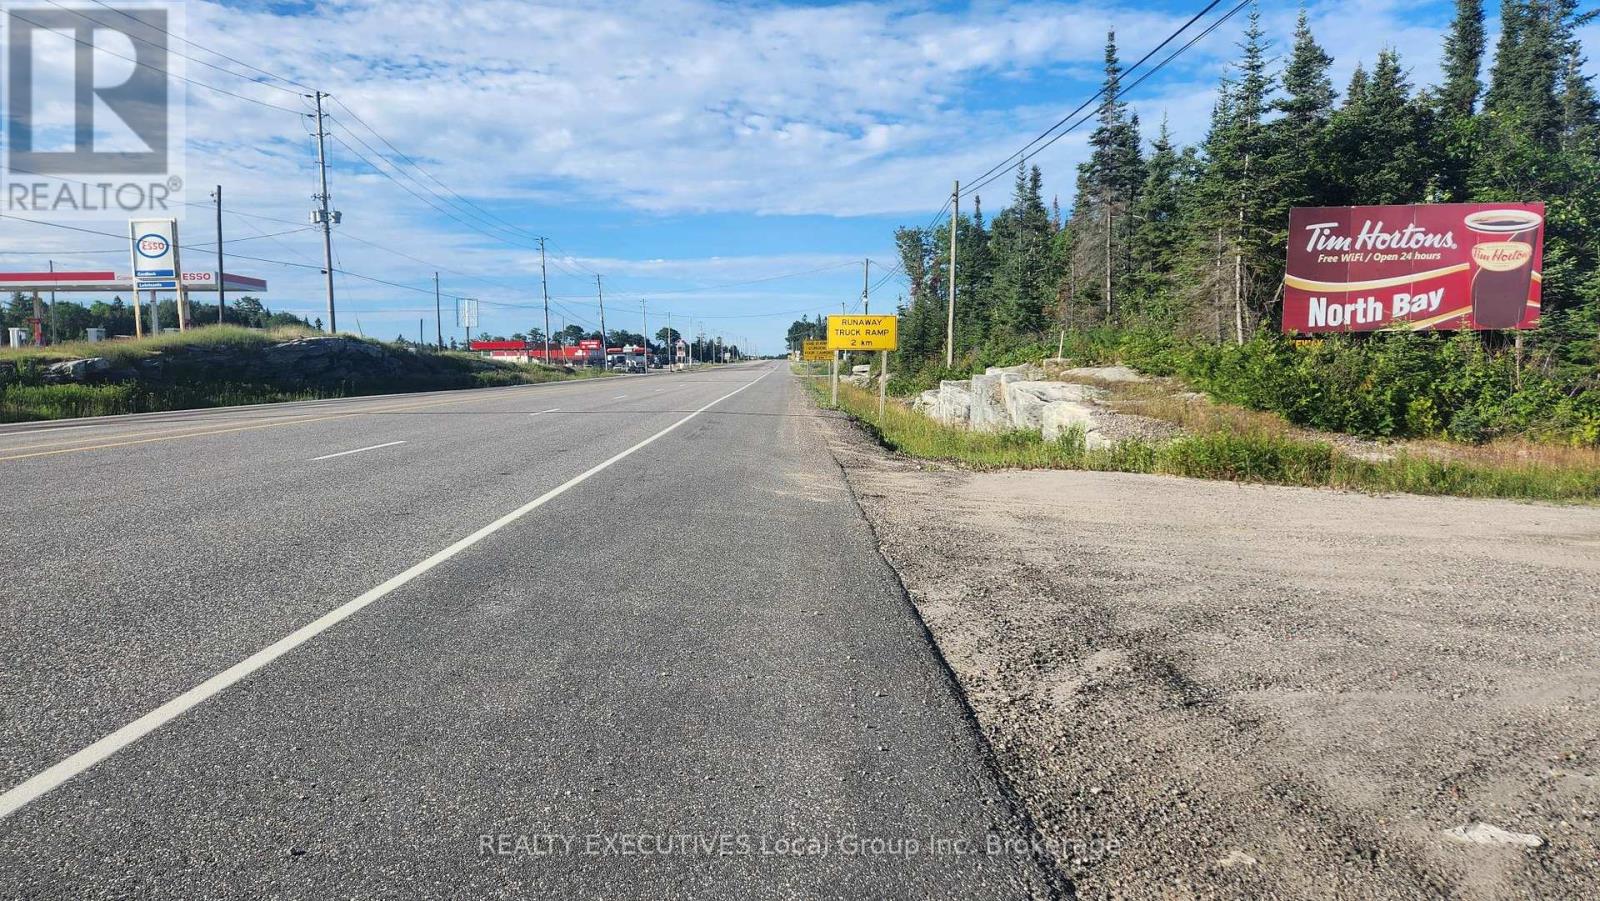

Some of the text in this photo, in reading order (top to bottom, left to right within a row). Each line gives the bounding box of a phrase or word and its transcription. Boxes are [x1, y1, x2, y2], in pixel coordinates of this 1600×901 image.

[1305, 222, 1352, 252] Tim
[1318, 253, 1339, 263] Free
[1341, 252, 1363, 262] WiFi
[1373, 252, 1398, 263] Open
[1400, 252, 1412, 261] 24
[1414, 251, 1441, 261] hours
[1308, 287, 1445, 328] North Bay
